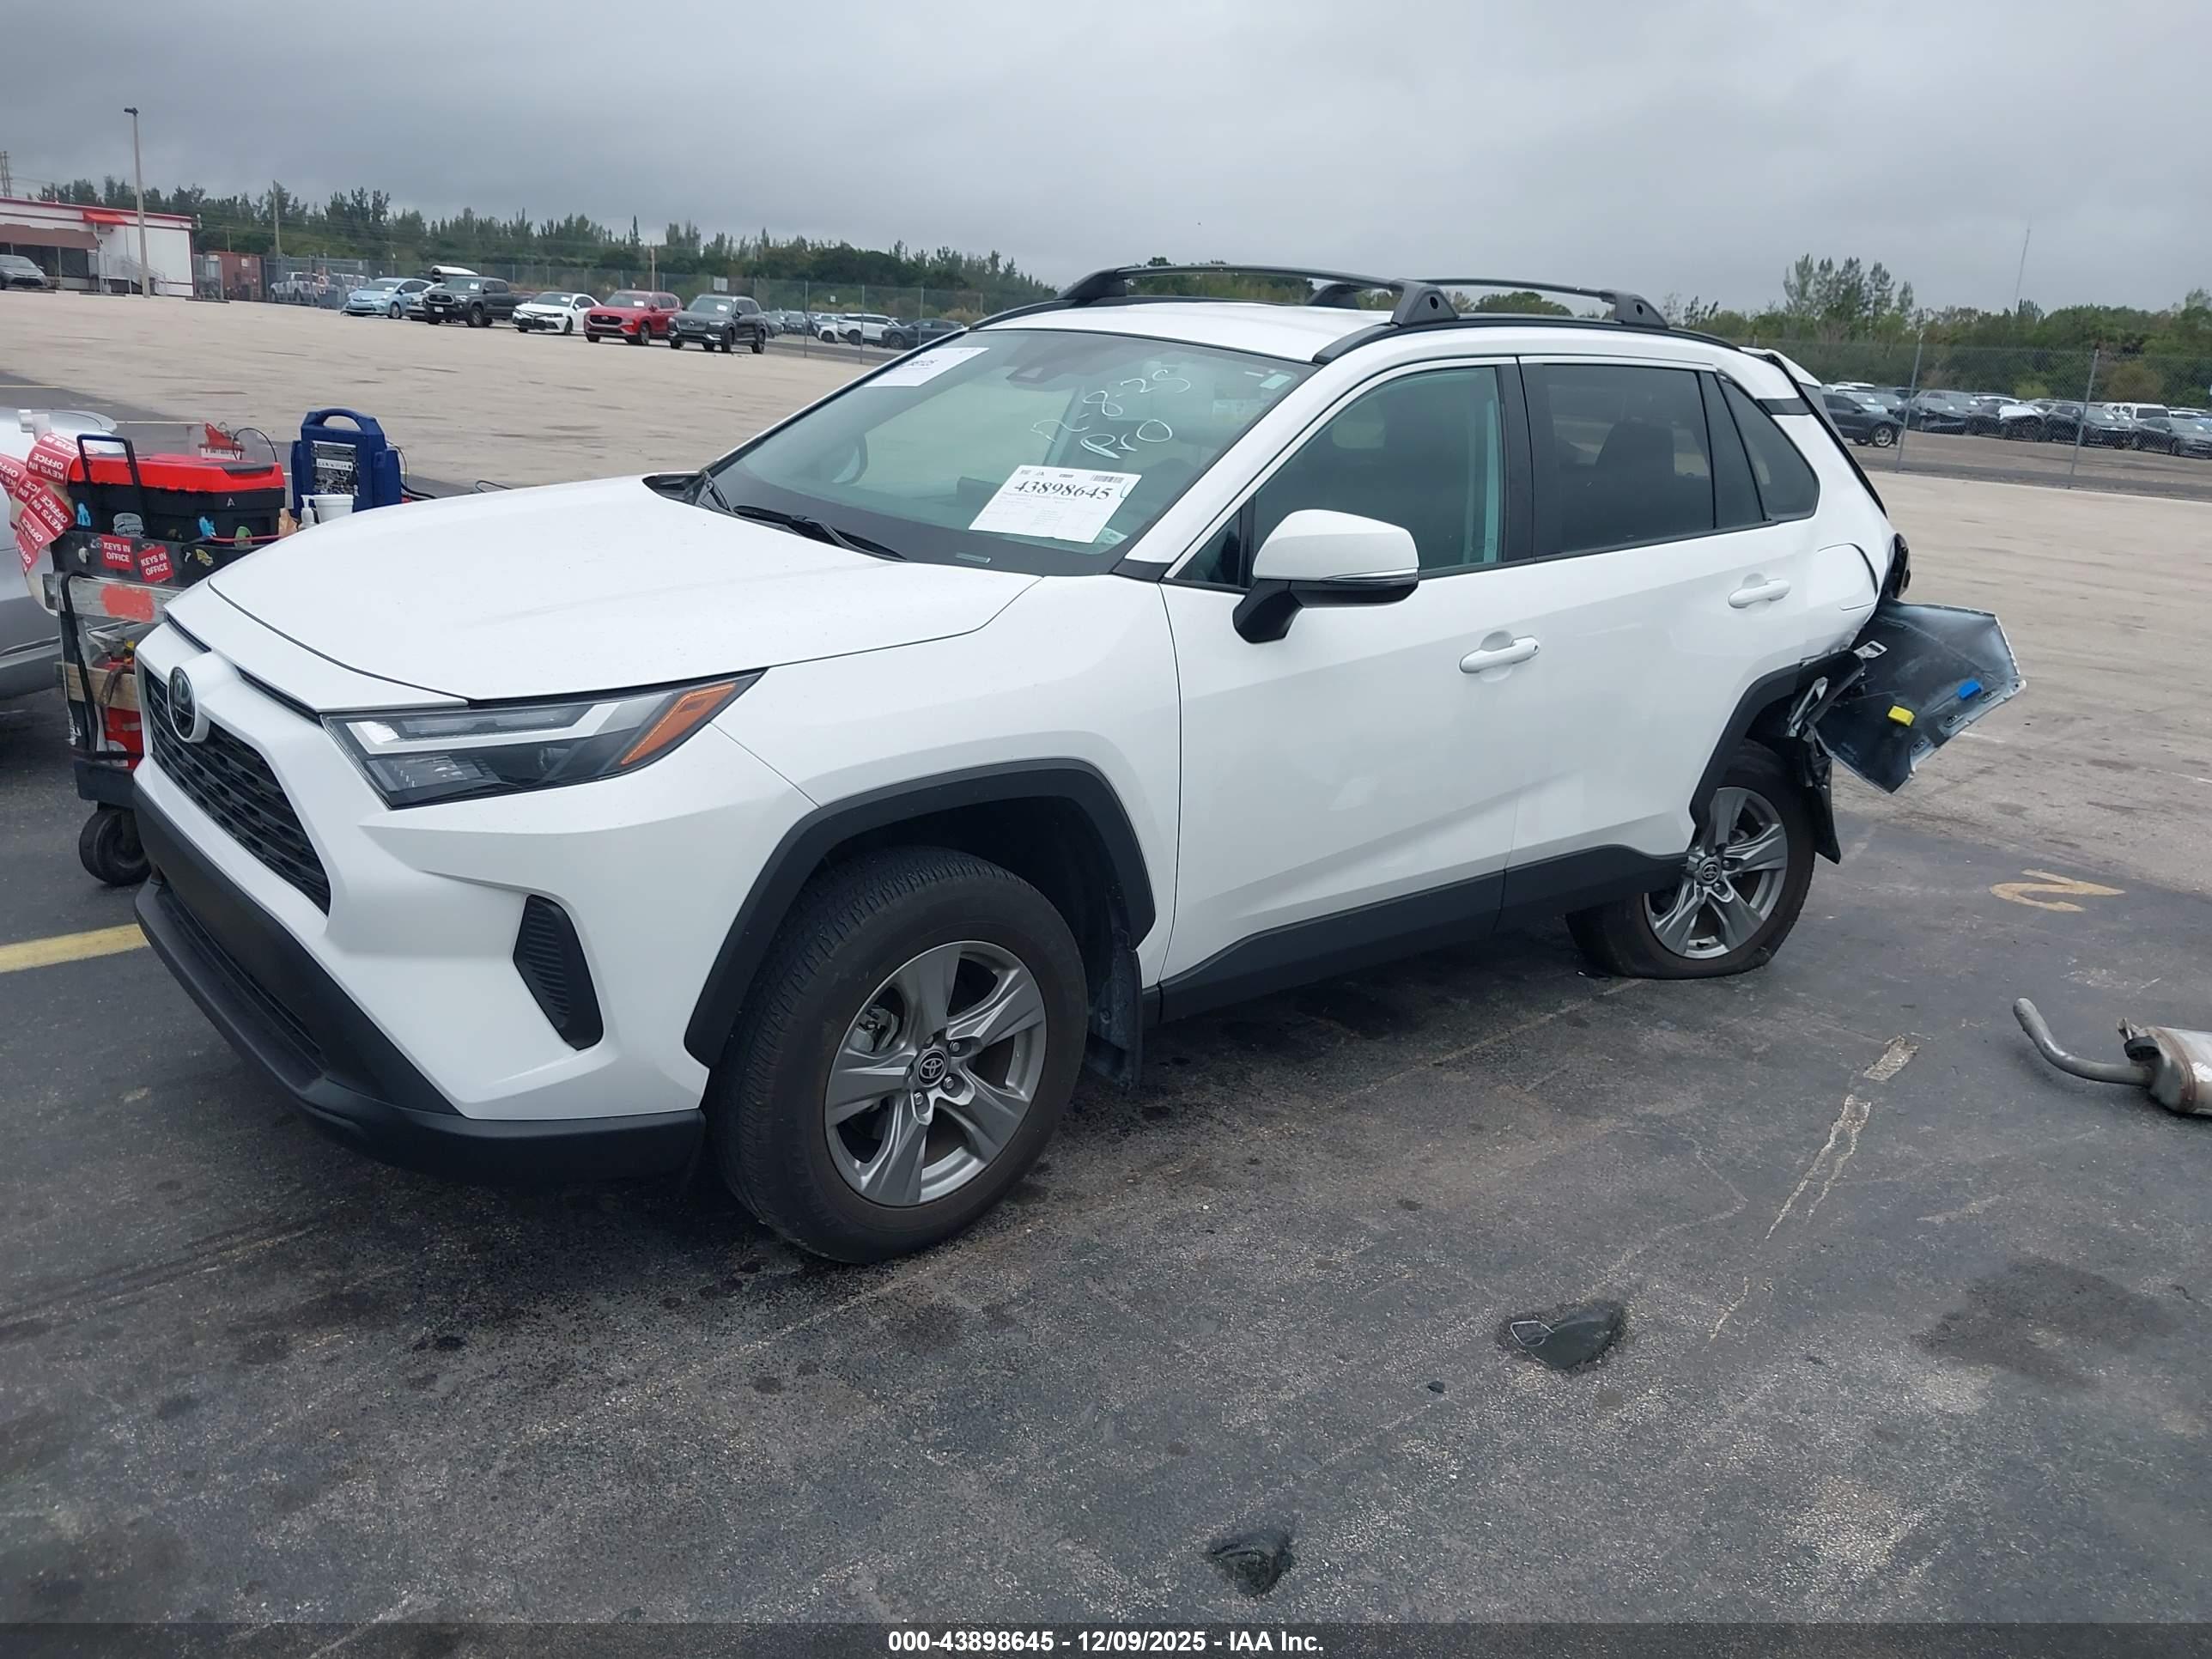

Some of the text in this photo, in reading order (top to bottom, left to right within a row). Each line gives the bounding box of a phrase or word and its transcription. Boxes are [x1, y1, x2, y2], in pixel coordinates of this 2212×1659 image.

[33, 453, 64, 470] OFFICE
[28, 461, 64, 481] KEYS IN
[1014, 480, 1113, 500] 43898645
[31, 500, 64, 531] KEYS IN
[40, 495, 68, 523] OFFICE
[103, 541, 122, 551] KEYS
[106, 552, 130, 562] OFFICE
[140, 552, 167, 567] KEYS IN
[145, 562, 168, 576] OFFICE
